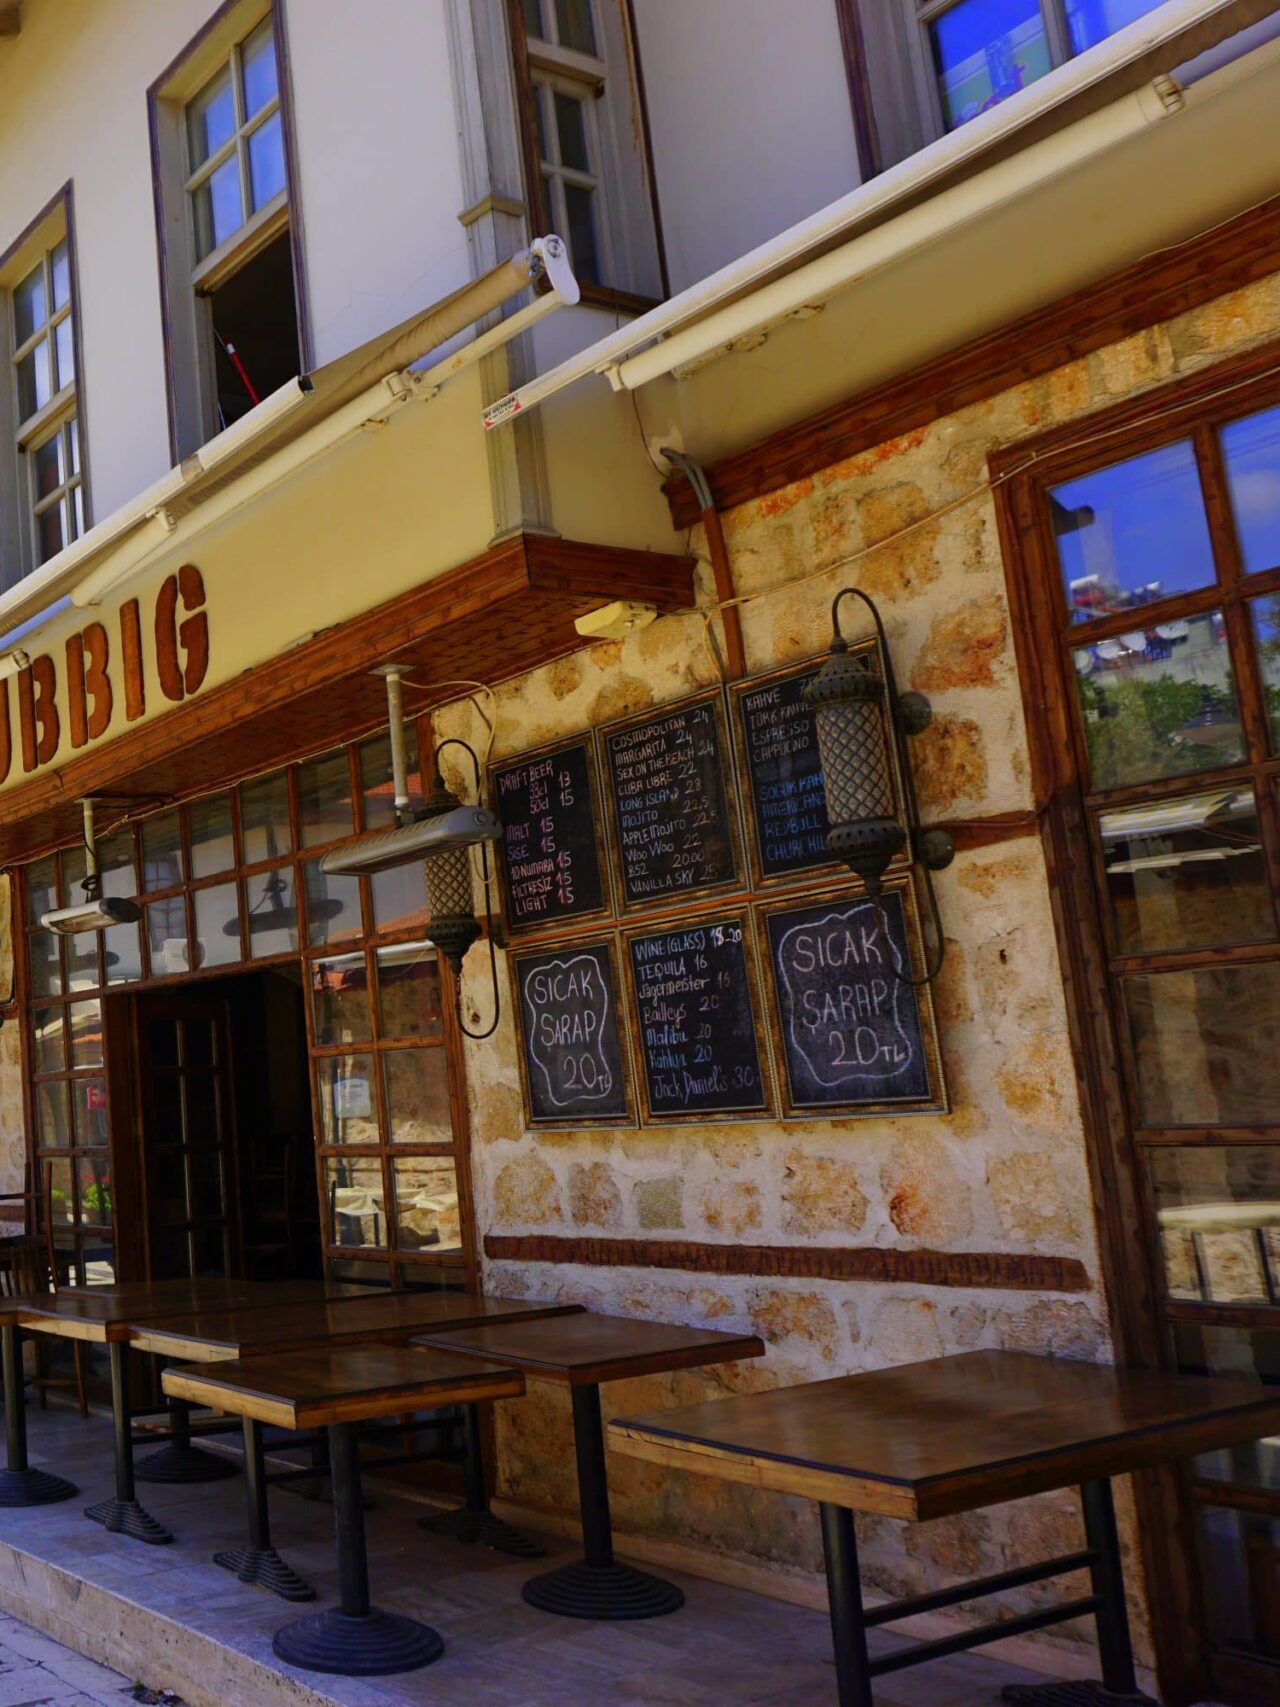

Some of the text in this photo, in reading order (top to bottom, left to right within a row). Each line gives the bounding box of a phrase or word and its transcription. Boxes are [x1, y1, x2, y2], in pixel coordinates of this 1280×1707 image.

[746, 688, 781, 711] KAHVE
[612, 710, 709, 750] COSMOPOLITAN 24
[676, 729, 693, 744] 24
[752, 720, 809, 746] ESPRESSO
[617, 740, 714, 781] SEX ON THE BEACH 24
[499, 760, 554, 797] DRAFT BEER
[558, 771, 571, 788] 13
[617, 761, 697, 796] CUBA LIBRE 22
[530, 789, 574, 814] 50cl 15
[620, 796, 643, 811] LONG
[684, 778, 702, 794] 28
[506, 816, 555, 841] MALT 15
[623, 827, 650, 845] APPLE
[683, 833, 702, 849] 22
[540, 836, 556, 853] 15
[557, 851, 571, 867] 15
[627, 862, 649, 878] B52
[556, 871, 572, 887] 15
[630, 873, 674, 893] VANILLA
[675, 867, 695, 885] SKY
[516, 887, 574, 915] LIGHT 15
[667, 930, 706, 955] (GLASS)
[793, 927, 882, 972] SICAK
[637, 953, 708, 980] TEQUILA 16
[534, 969, 593, 1004] SICAK
[718, 971, 731, 989] 16
[699, 995, 720, 1011] 20
[802, 979, 888, 1035] ŞARAP
[541, 1010, 596, 1053] ŞARAP
[647, 1023, 712, 1047] Malibu 20
[694, 1045, 712, 1062] 20
[653, 1071, 683, 1099] Jack
[733, 1066, 754, 1088] 30
